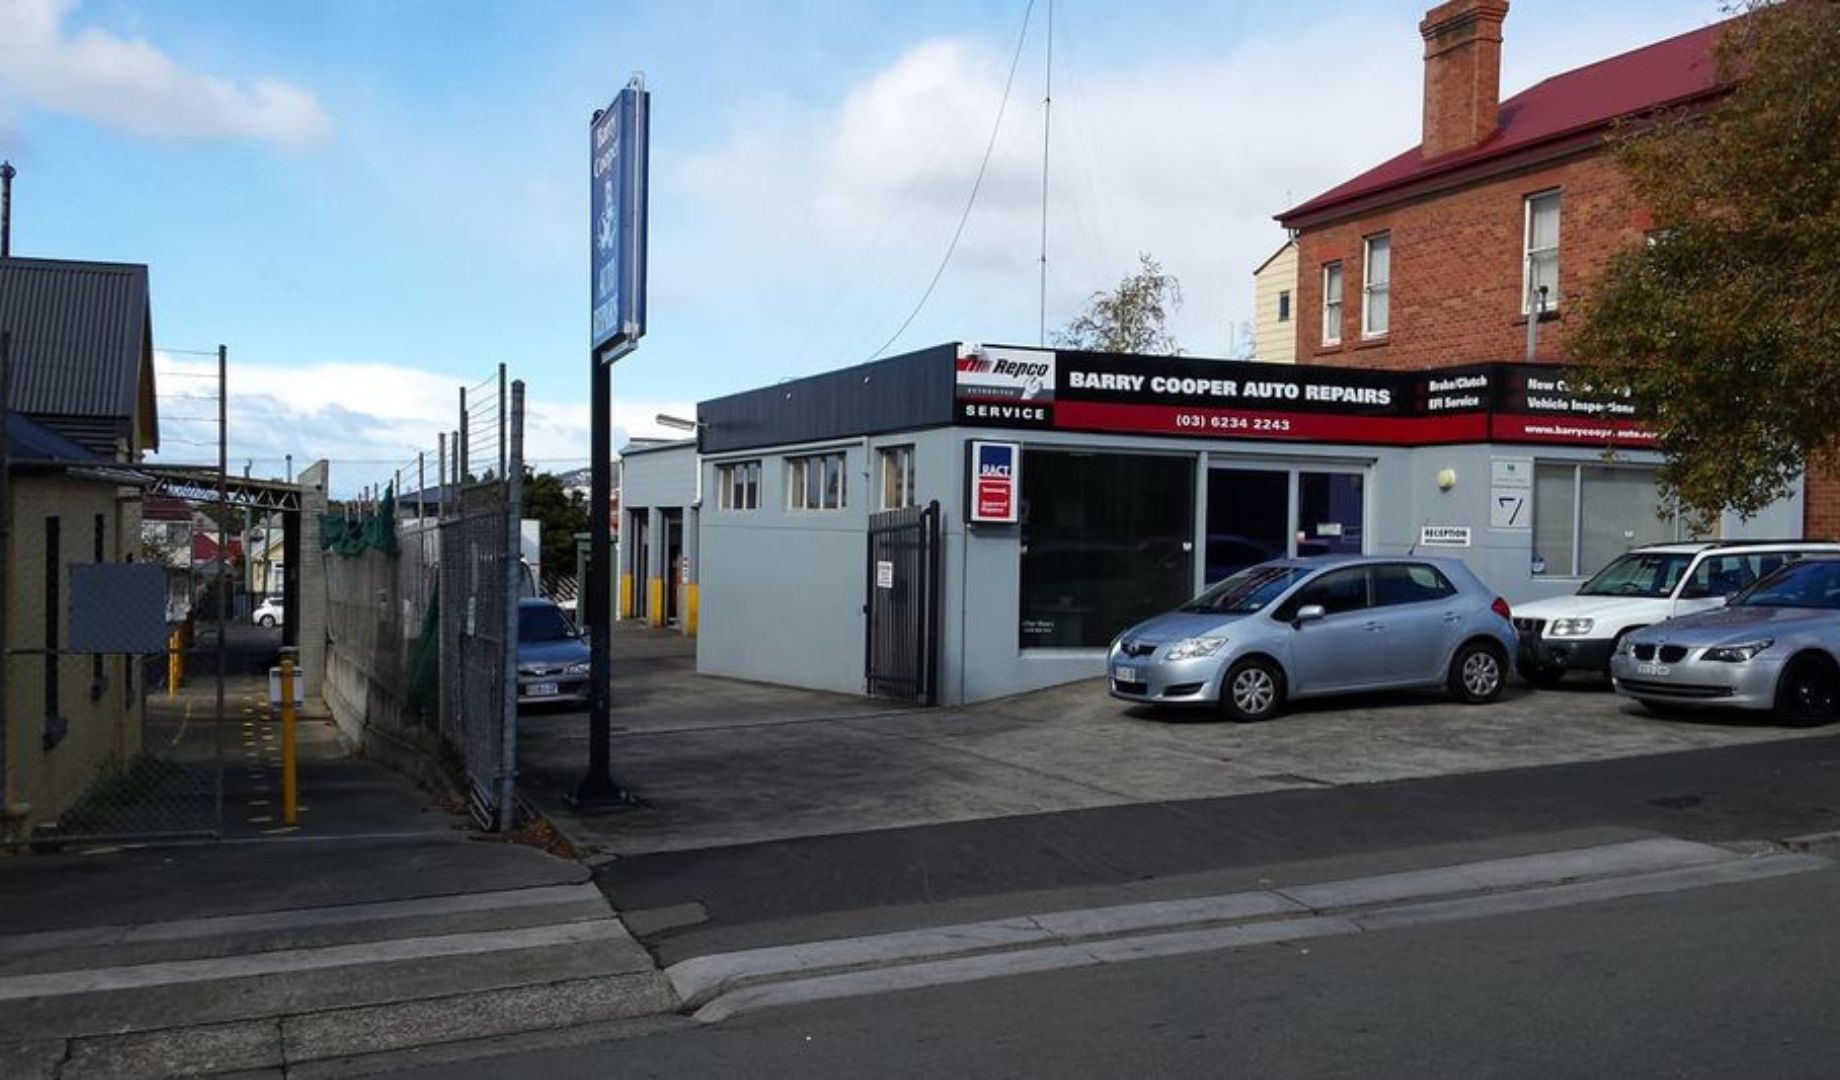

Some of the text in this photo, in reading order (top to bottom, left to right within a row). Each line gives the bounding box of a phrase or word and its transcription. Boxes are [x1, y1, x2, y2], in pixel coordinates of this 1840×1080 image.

[993, 358, 1050, 378] Repco
[1069, 371, 1391, 404] BARRY COOPER AUTO REPAIRS
[1527, 378, 1554, 391] New
[1429, 395, 1480, 410] EFI Service
[1527, 396, 1569, 411] Vehicle
[965, 404, 1045, 420] SERVICE
[1176, 415, 1291, 431] (03) 6234 2243
[981, 463, 1010, 477] RACT
[1424, 528, 1468, 538] RECEPTION
